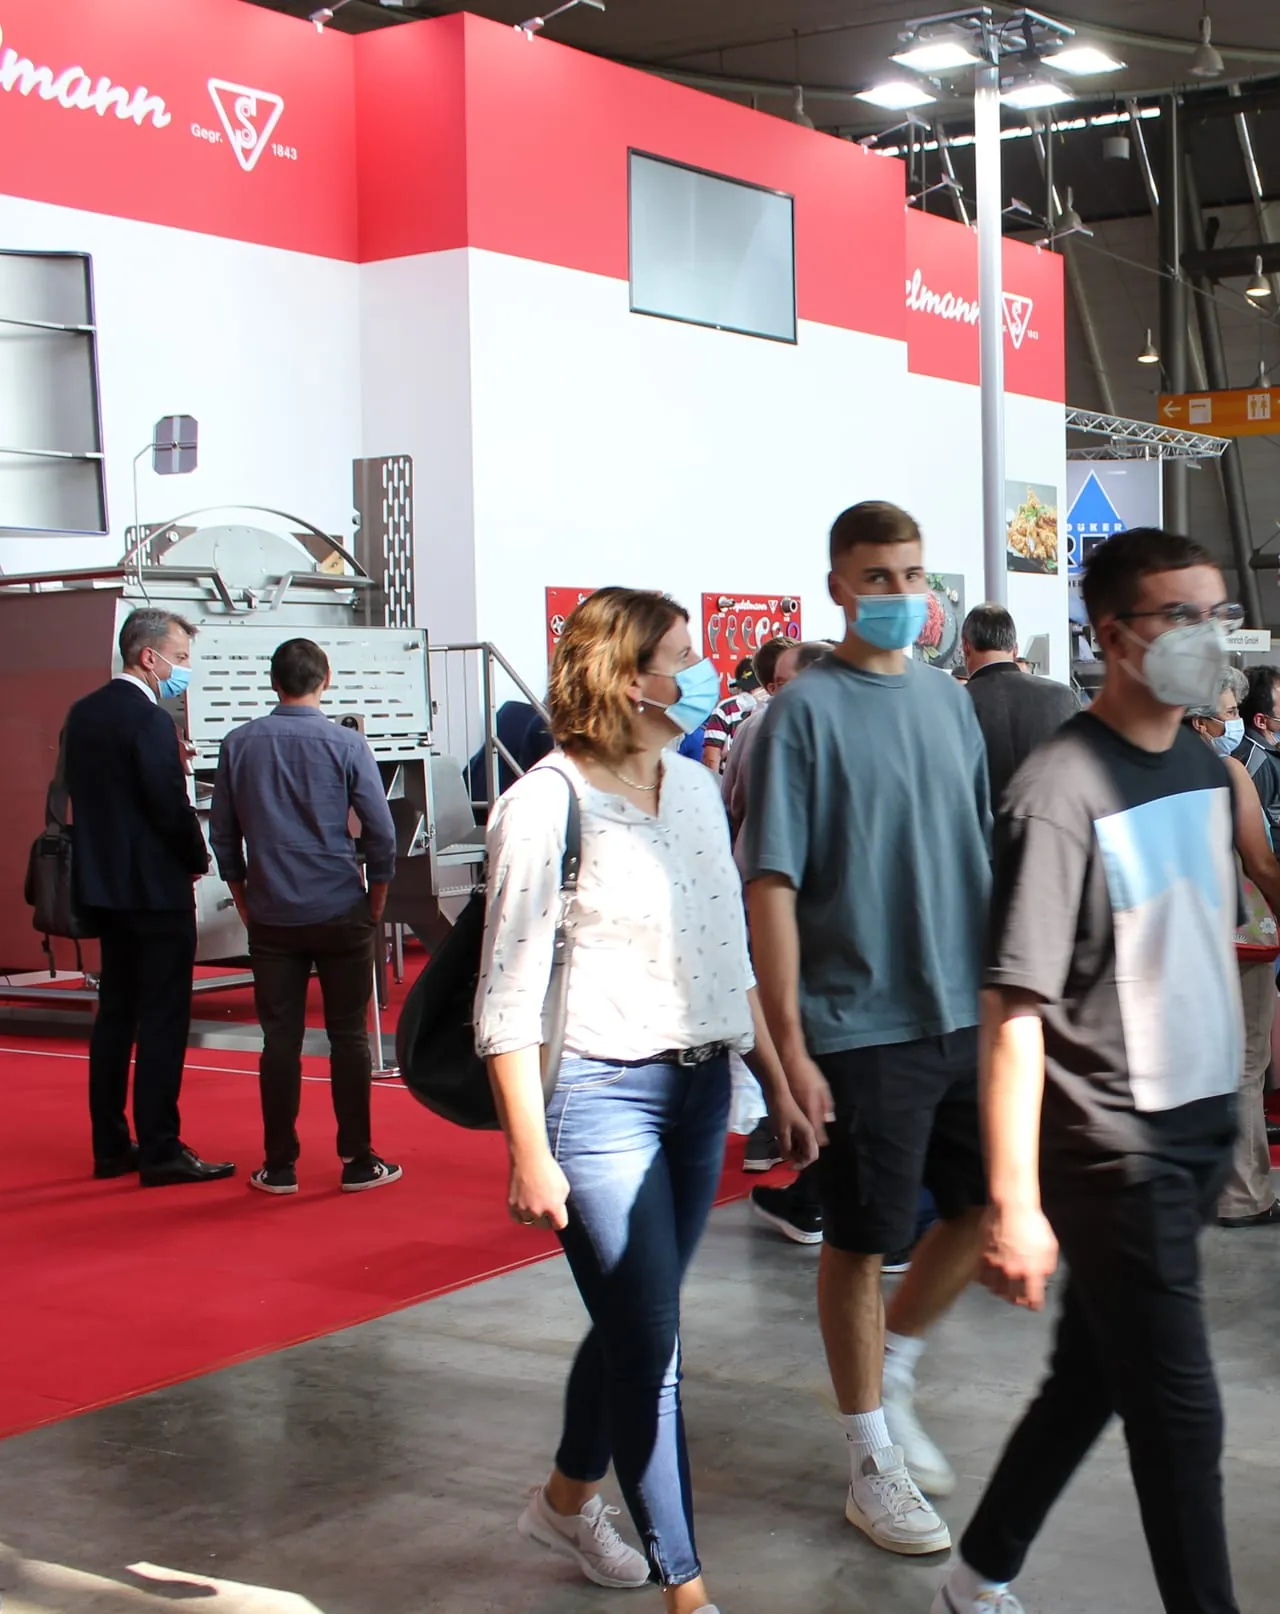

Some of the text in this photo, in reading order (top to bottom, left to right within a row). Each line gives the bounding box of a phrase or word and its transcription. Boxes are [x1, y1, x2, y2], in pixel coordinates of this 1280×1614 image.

[0, 25, 172, 129] mann
[191, 123, 224, 143] Gegr.
[271, 143, 298, 160] 1843
